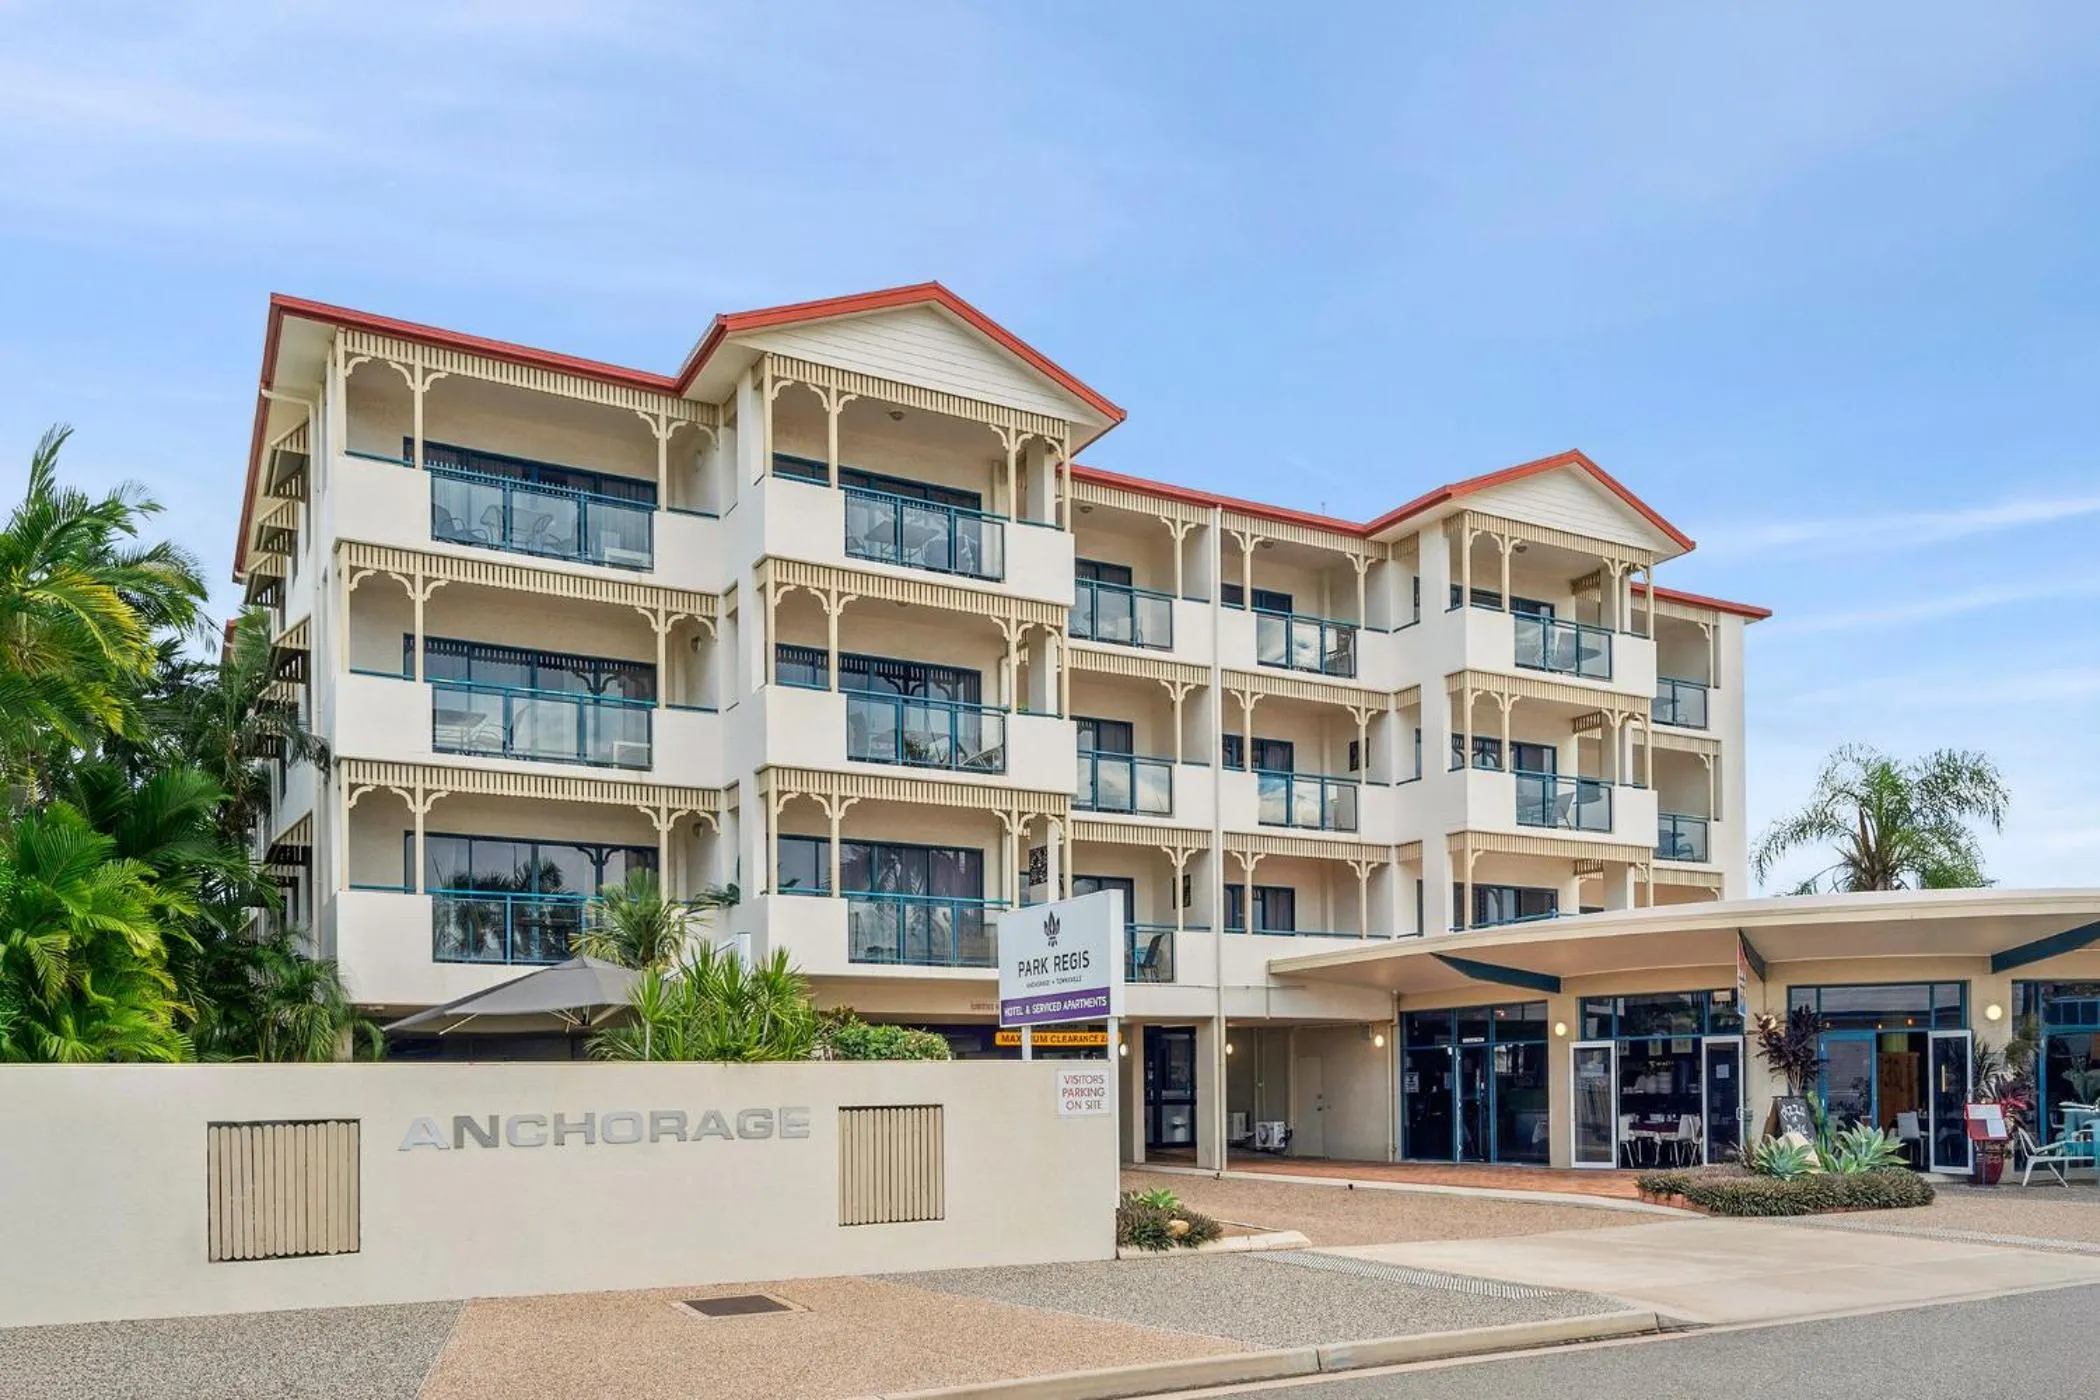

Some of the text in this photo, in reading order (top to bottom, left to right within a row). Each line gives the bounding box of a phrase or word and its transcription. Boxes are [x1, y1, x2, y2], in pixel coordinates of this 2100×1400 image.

[1018, 950, 1090, 977] PARK REGIS
[1004, 996, 1107, 1017] HOTEL & SERVICED APARTMENTS
[1001, 1034, 1048, 1043] MAXUM
[1050, 1034, 1099, 1043] CLEARANCE
[1063, 1074, 1104, 1084] VISITORS
[1062, 1087, 1104, 1097] PARKING
[1065, 1100, 1102, 1110] ON SITE
[398, 1107, 810, 1151] ANCHORAGE
